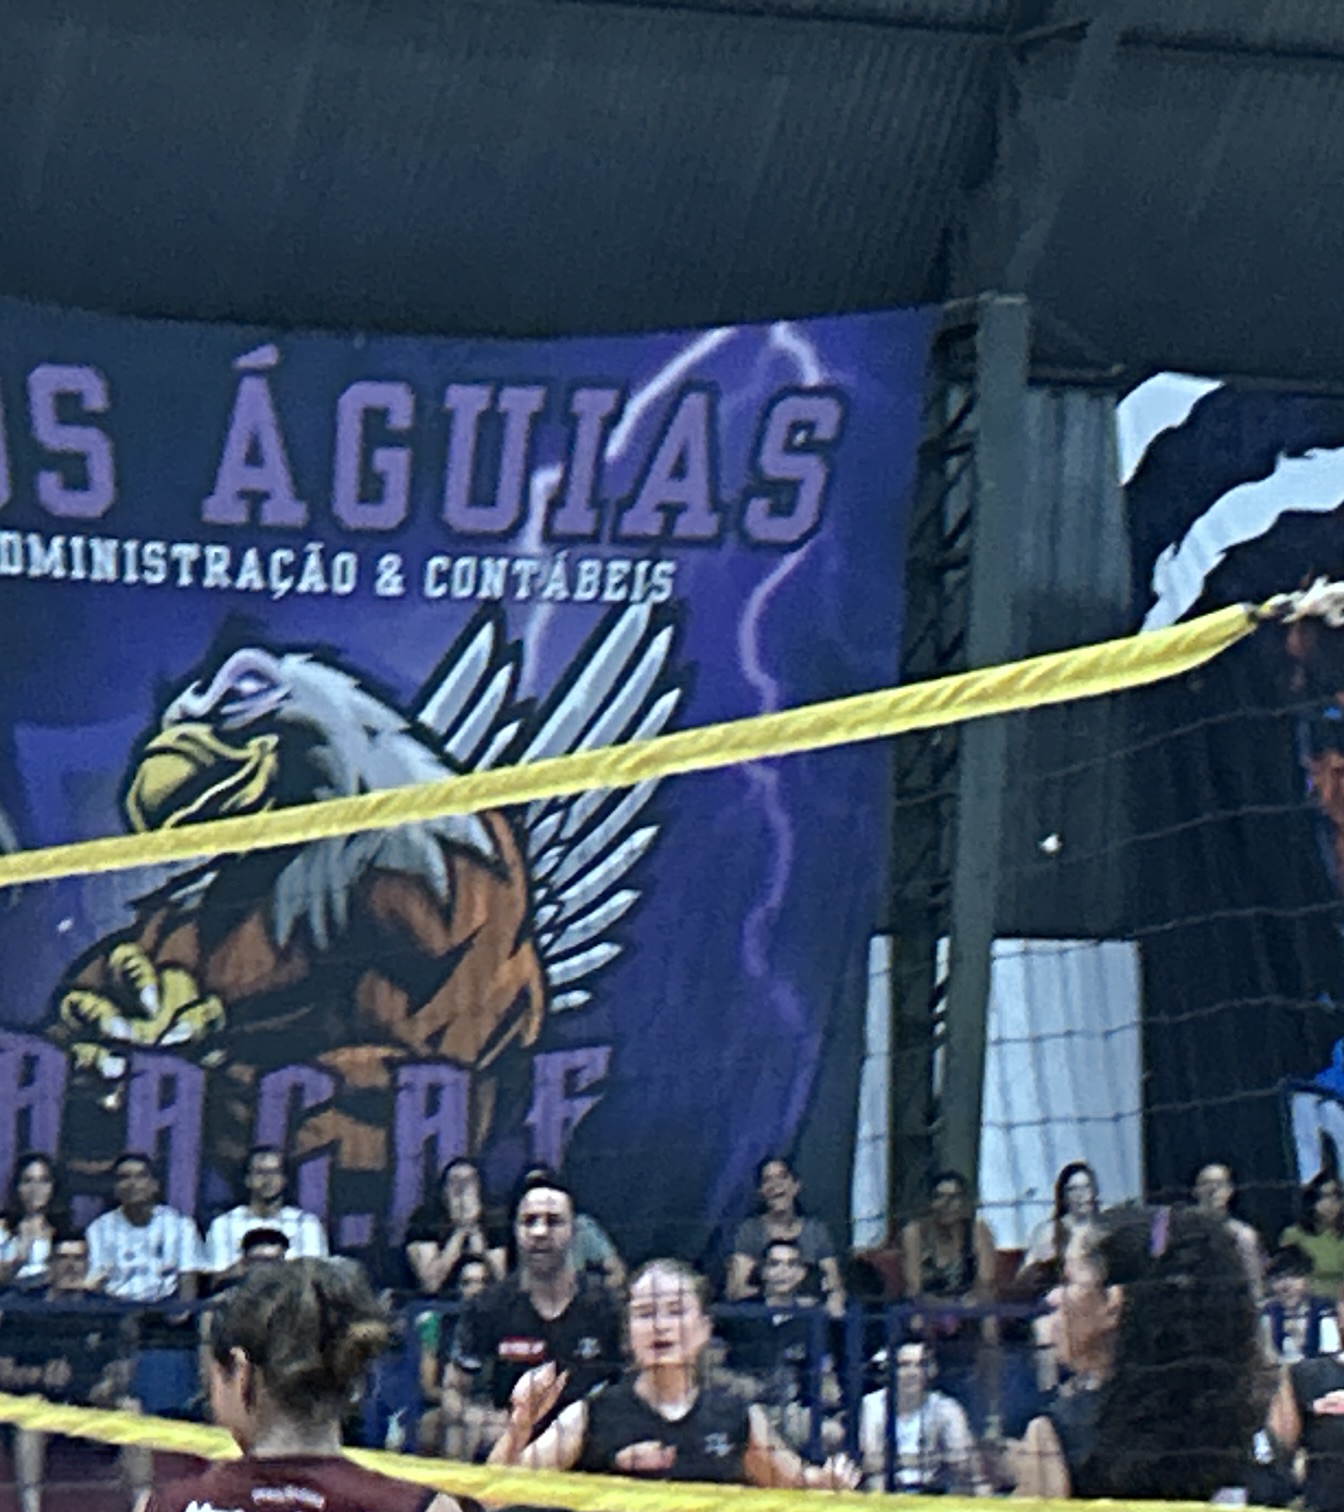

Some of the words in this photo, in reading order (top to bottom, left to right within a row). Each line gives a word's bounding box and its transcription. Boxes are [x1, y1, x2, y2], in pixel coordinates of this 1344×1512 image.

[202, 345, 844, 540] ÁGUIAS
[375, 554, 406, 597] &
[424, 550, 677, 604] CONTÁBEIS
